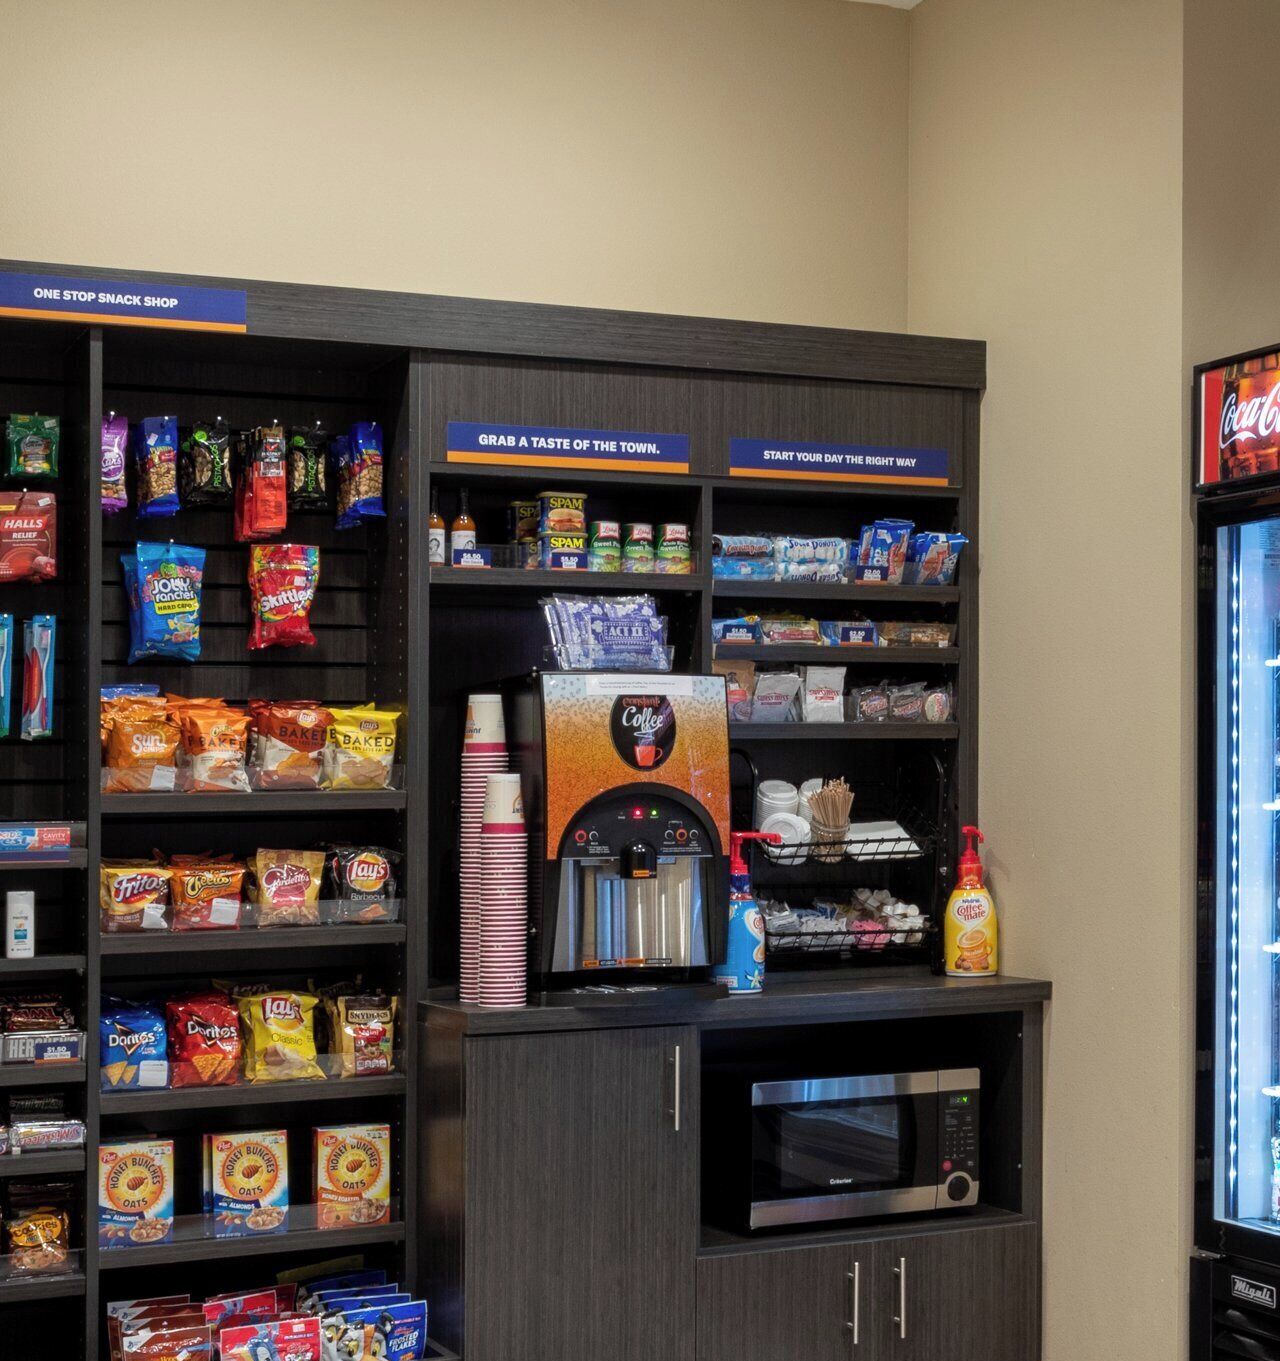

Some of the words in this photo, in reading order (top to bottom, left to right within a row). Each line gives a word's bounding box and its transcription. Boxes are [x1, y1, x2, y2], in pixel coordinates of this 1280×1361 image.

[33, 287, 61, 300] ONE
[63, 290, 96, 302] STOP
[98, 292, 142, 306] SNACK
[144, 295, 178, 309] SHOP
[478, 434, 516, 447] GRAB
[518, 436, 528, 448] A
[531, 437, 570, 450] TASTE
[573, 439, 591, 451] OF
[593, 440, 617, 452] THE
[619, 441, 660, 454] TOWN.
[763, 450, 794, 461] START
[796, 452, 822, 462] YOUR
[824, 453, 843, 463] DAY
[844, 454, 864, 464] THE
[865, 455, 894, 466] RIGHT
[896, 457, 916, 467] WAY
[549, 497, 583, 509] SPAM
[4, 519, 43, 529] HALLS
[550, 537, 584, 549] SPAM
[610, 627, 628, 637] ACT
[622, 705, 663, 732] Coffee
[131, 733, 167, 753] Sun
[342, 735, 394, 747] BAKED
[351, 861, 386, 880] Lay's
[115, 874, 166, 901] Fritos
[957, 904, 985, 917] Coffee
[963, 910, 986, 921] mate
[187, 1015, 238, 1039] Doritos
[109, 1031, 155, 1047] Doritos
[271, 1033, 303, 1046] Classic
[226, 1149, 243, 1177] HONEY
[246, 1146, 275, 1174] BUNCHES
[330, 1144, 347, 1171] HONEY
[110, 1161, 128, 1189] HONEY
[132, 1158, 160, 1185] BUNCHES
[239, 1187, 263, 1196] OATS
[342, 1180, 366, 1189] OATS
[123, 1197, 148, 1208] OATS
[229, 1202, 255, 1210] ALMONDS
[389, 1331, 420, 1347] FROSTED
[391, 1341, 417, 1353] FLAKES
